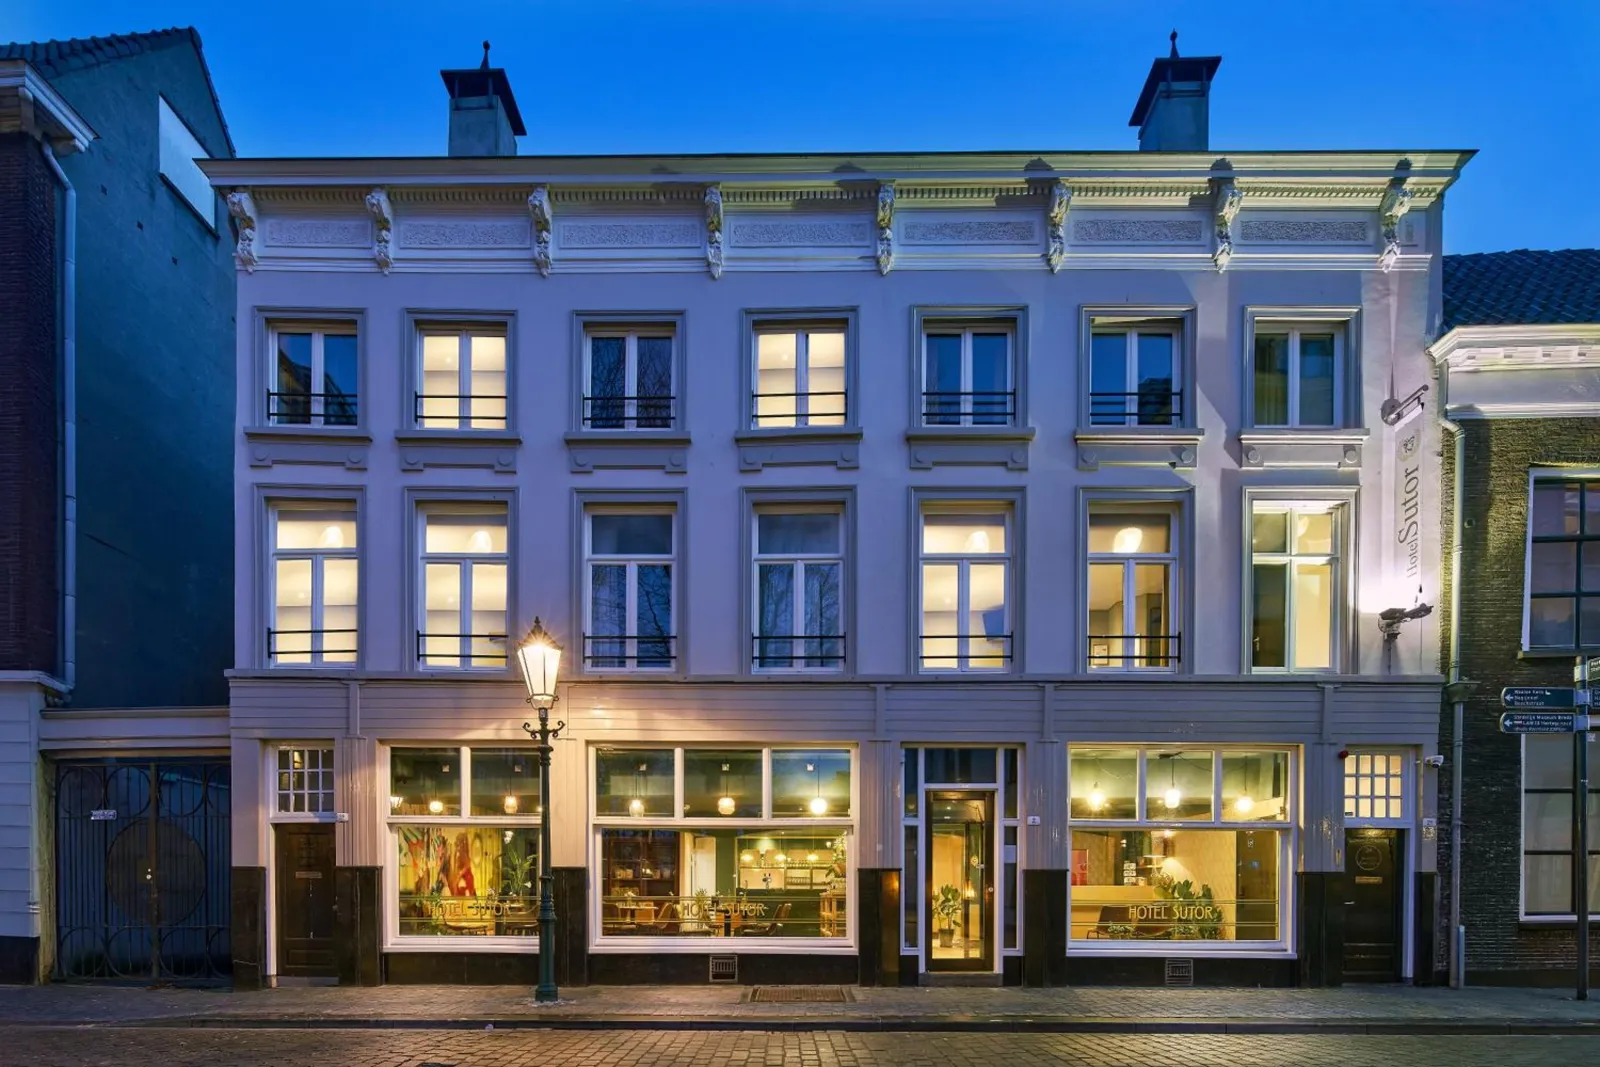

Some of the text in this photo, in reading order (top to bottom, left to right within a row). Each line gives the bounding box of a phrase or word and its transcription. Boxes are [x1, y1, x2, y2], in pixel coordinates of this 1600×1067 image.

[1398, 464, 1420, 544] Sutor
[428, 902, 512, 917] HOTEL SUTOR
[724, 902, 766, 917] SUTOR
[1128, 905, 1213, 920] HOTEL SUTOR
